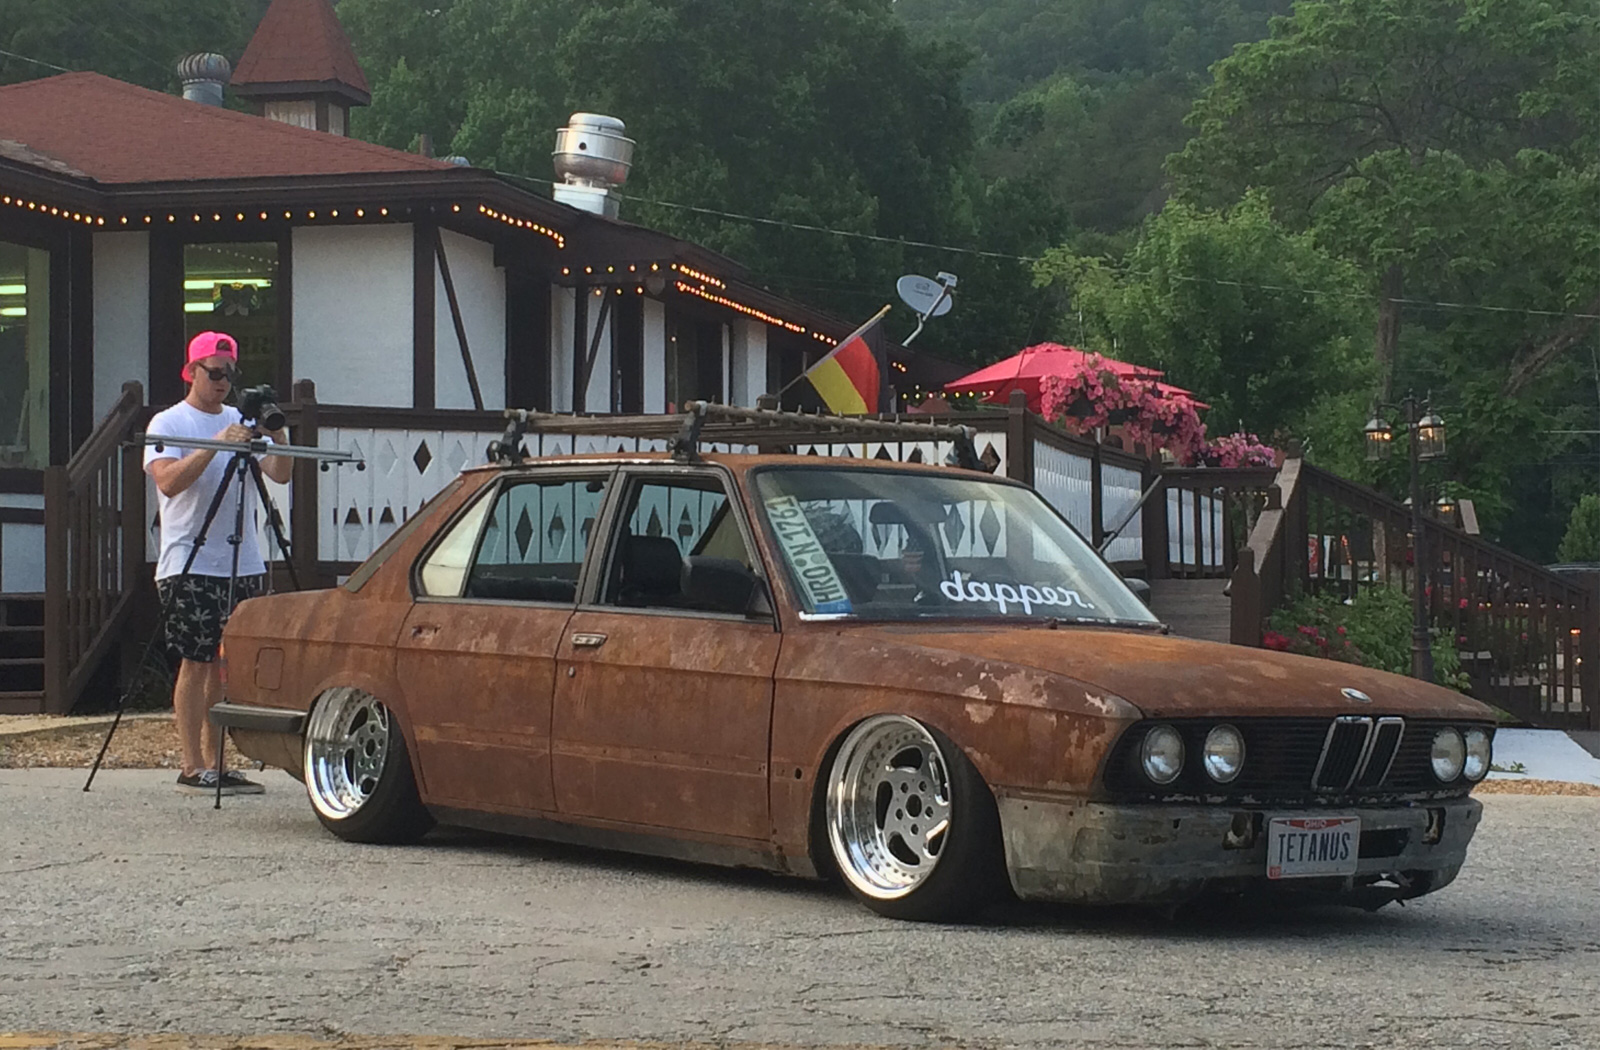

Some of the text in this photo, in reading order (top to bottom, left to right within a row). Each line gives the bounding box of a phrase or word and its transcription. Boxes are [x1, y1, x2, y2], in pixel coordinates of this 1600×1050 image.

[767, 497, 844, 603] HRO N 1761
[940, 570, 1095, 615] dapper.
[1303, 819, 1327, 829] OHIO
[1279, 832, 1350, 863] TETANUS
